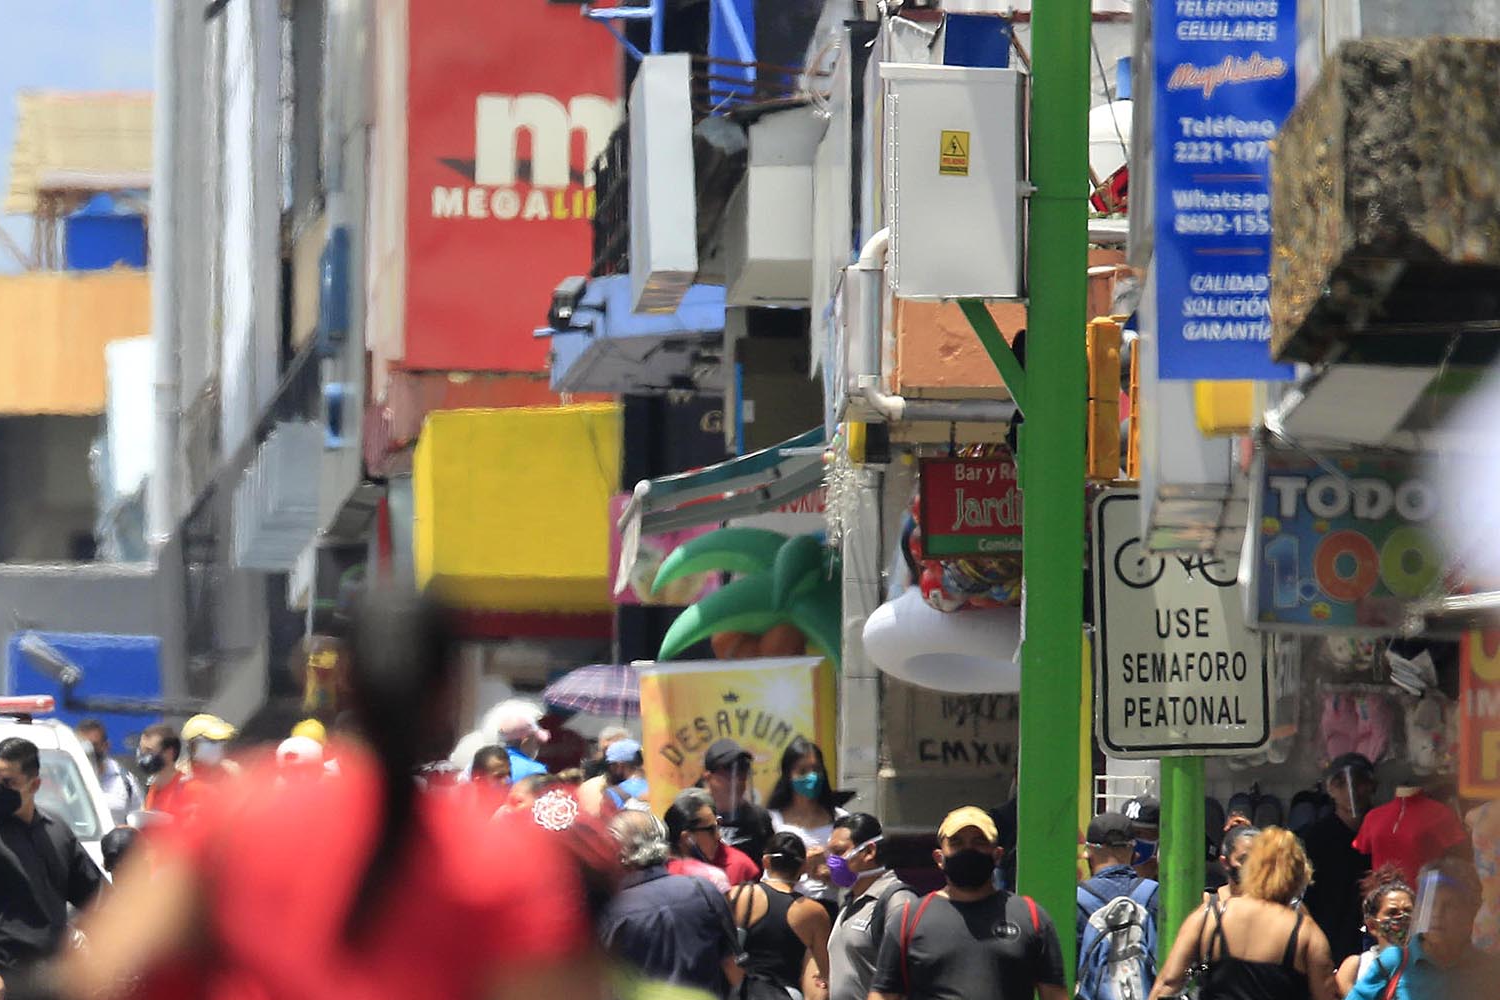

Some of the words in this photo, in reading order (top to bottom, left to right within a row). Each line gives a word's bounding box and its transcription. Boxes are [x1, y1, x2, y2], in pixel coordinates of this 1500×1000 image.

[1177, 20, 1278, 41] CELULARES
[1179, 115, 1276, 138] Teléfono
[1173, 141, 1269, 163] 2221-197
[1190, 273, 1269, 293] CALIDAD
[955, 463, 982, 481] Bar
[986, 467, 996, 485] y
[1268, 474, 1440, 521] TODO
[1155, 607, 1210, 639] USE
[1122, 651, 1248, 684] SEMAFORO
[1124, 696, 1248, 729] PEATONAL
[660, 708, 793, 768] DESAYUN
